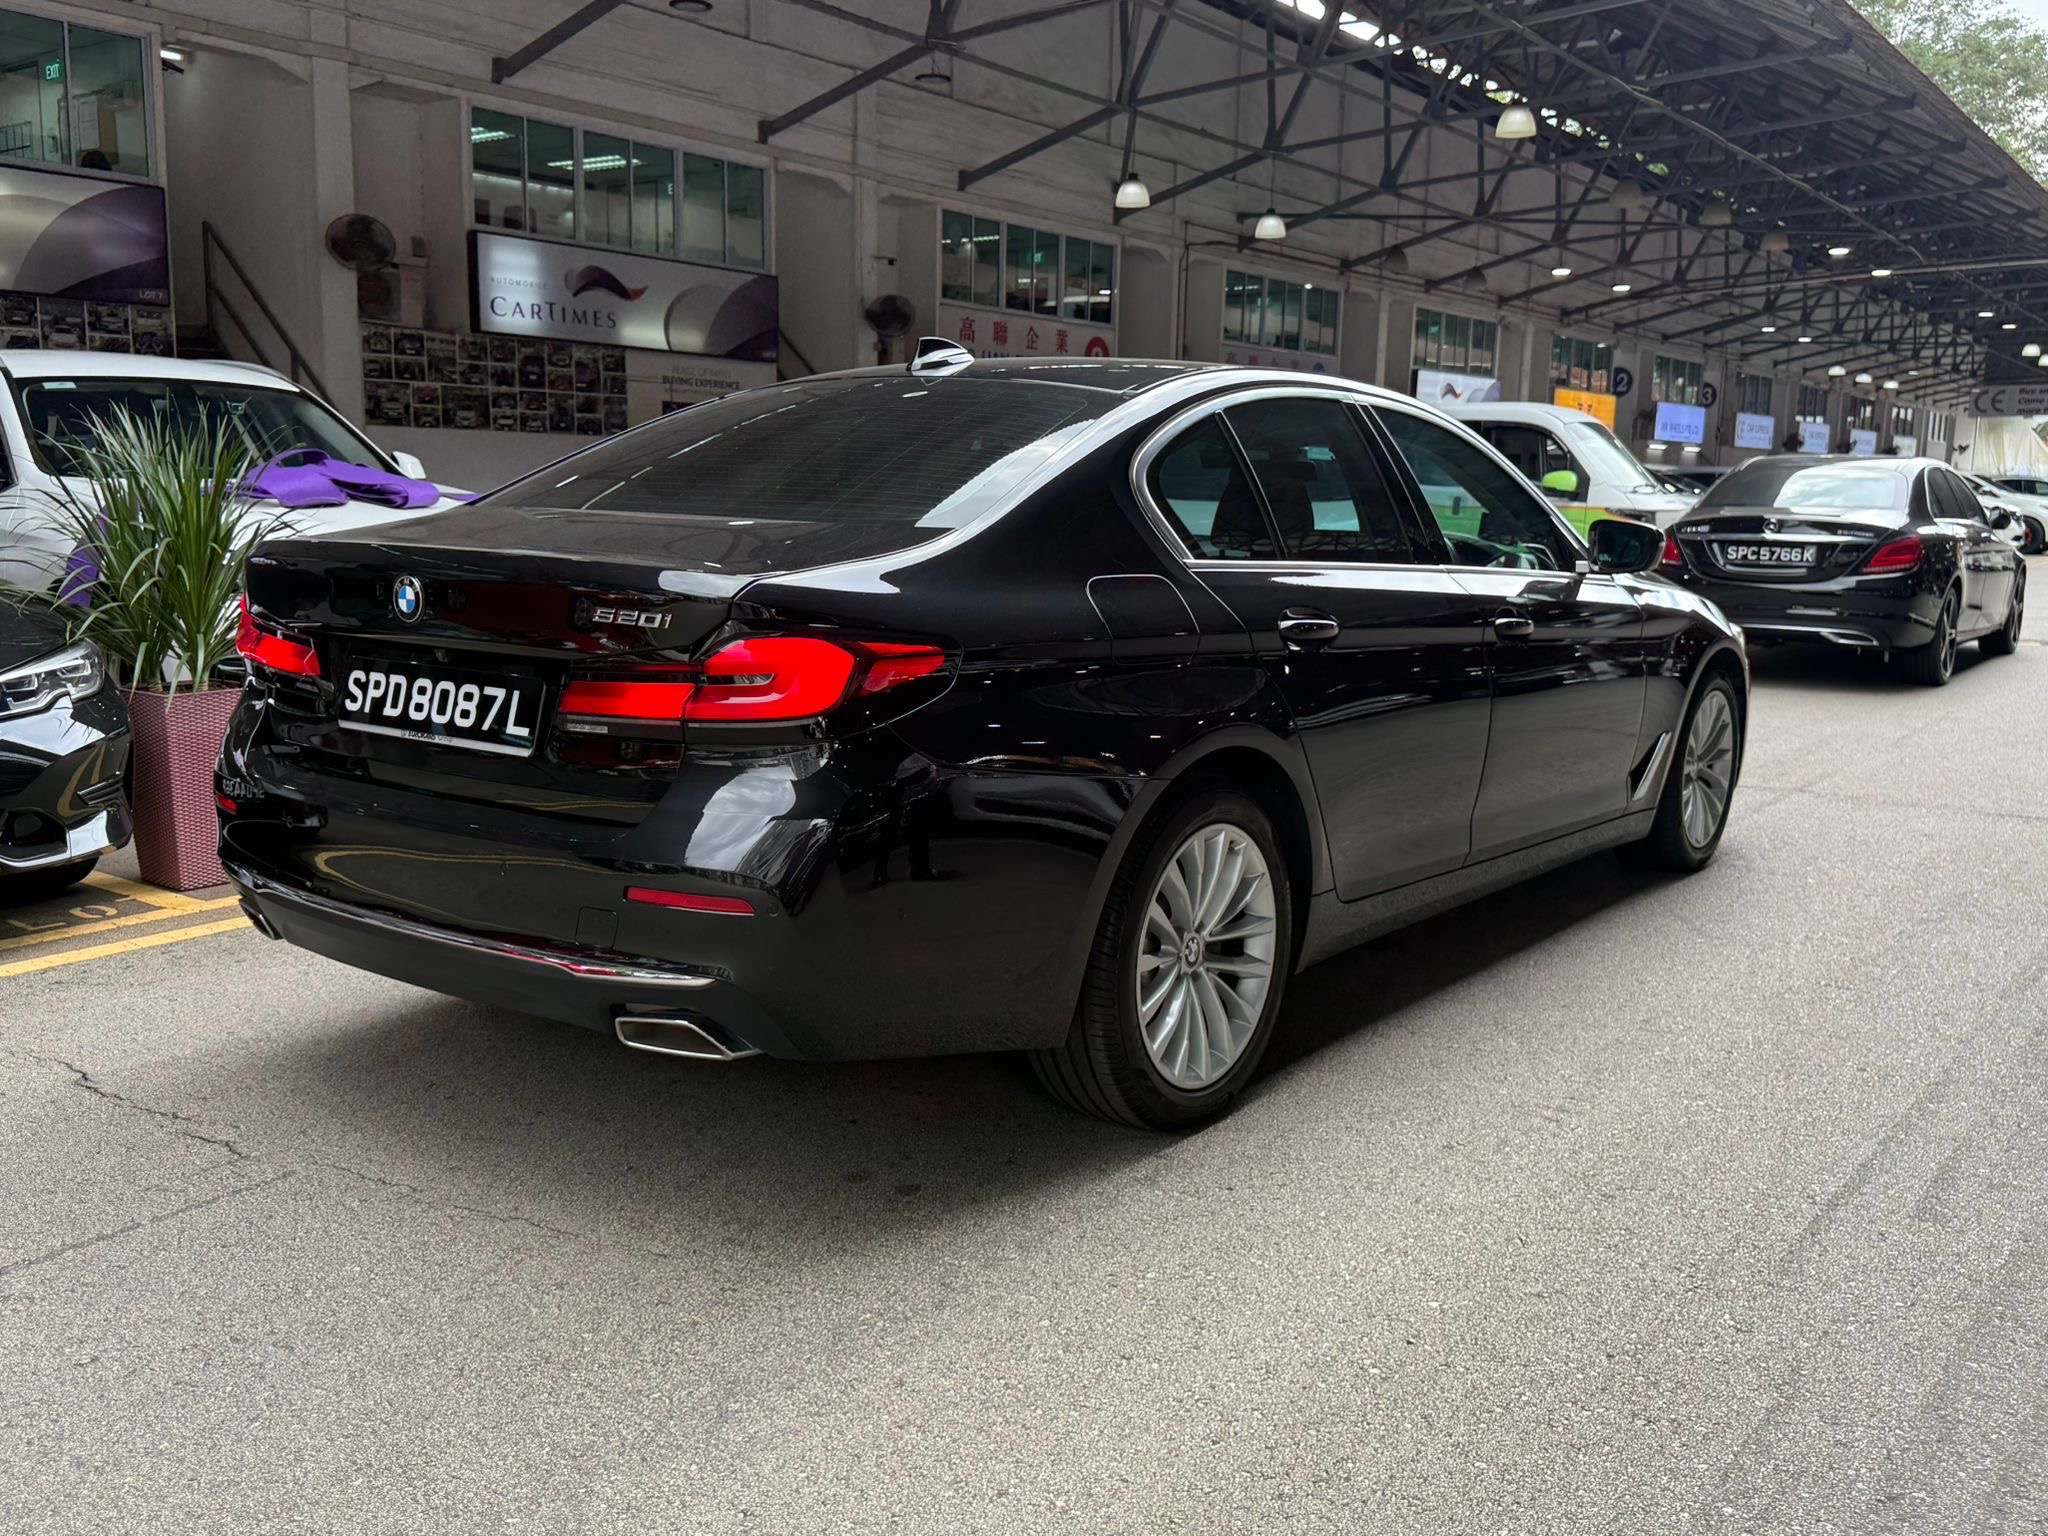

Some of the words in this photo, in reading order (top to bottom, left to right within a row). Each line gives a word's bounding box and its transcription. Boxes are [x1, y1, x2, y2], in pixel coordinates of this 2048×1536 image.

[46, 63, 60, 80] EXIT
[662, 375, 694, 387] BUYING
[695, 378, 740, 390] EXPERIENCE
[1617, 373, 1628, 392] 2
[1703, 386, 1713, 405] 3
[1727, 545, 1813, 562] SPC5766K
[592, 607, 673, 629] 520i
[344, 669, 531, 737] SPD8087L
